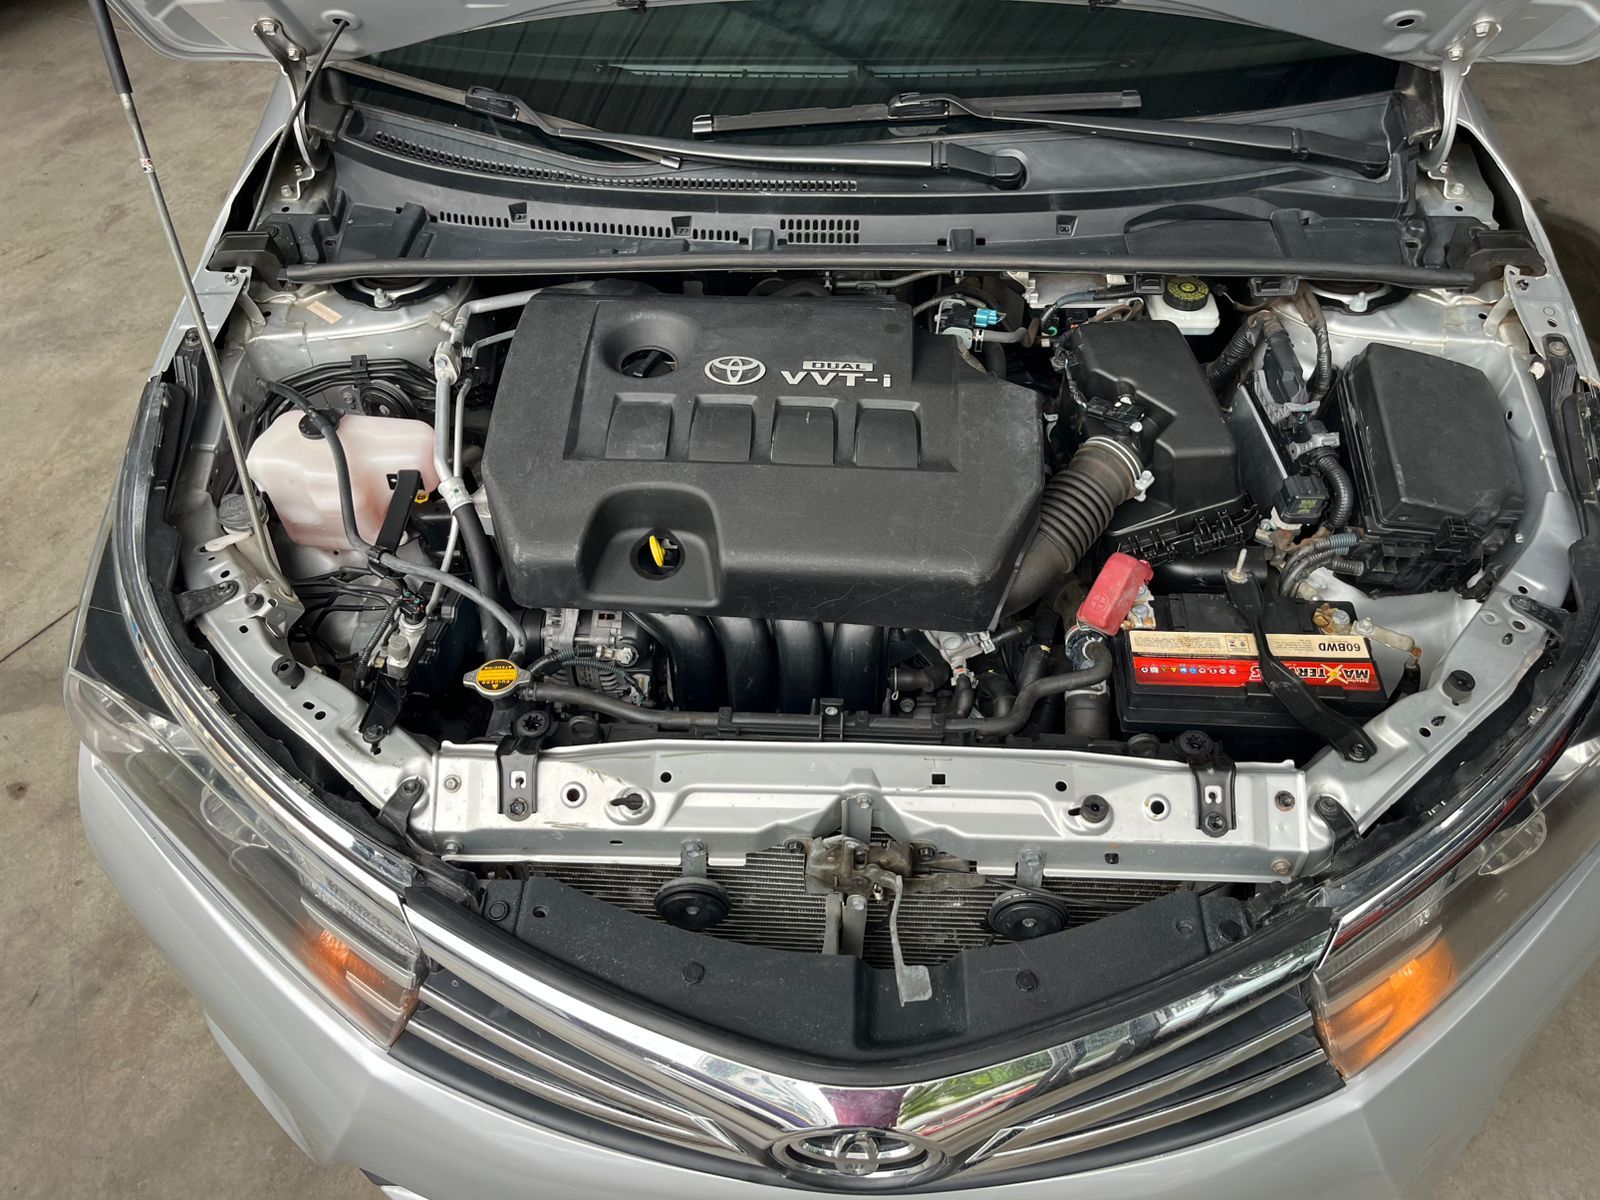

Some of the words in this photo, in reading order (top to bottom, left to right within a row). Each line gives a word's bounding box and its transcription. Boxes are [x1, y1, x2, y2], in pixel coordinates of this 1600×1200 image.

[811, 362, 868, 371] DUAL
[780, 371, 892, 388] VVT-i
[1318, 642, 1361, 652] 60BWD
